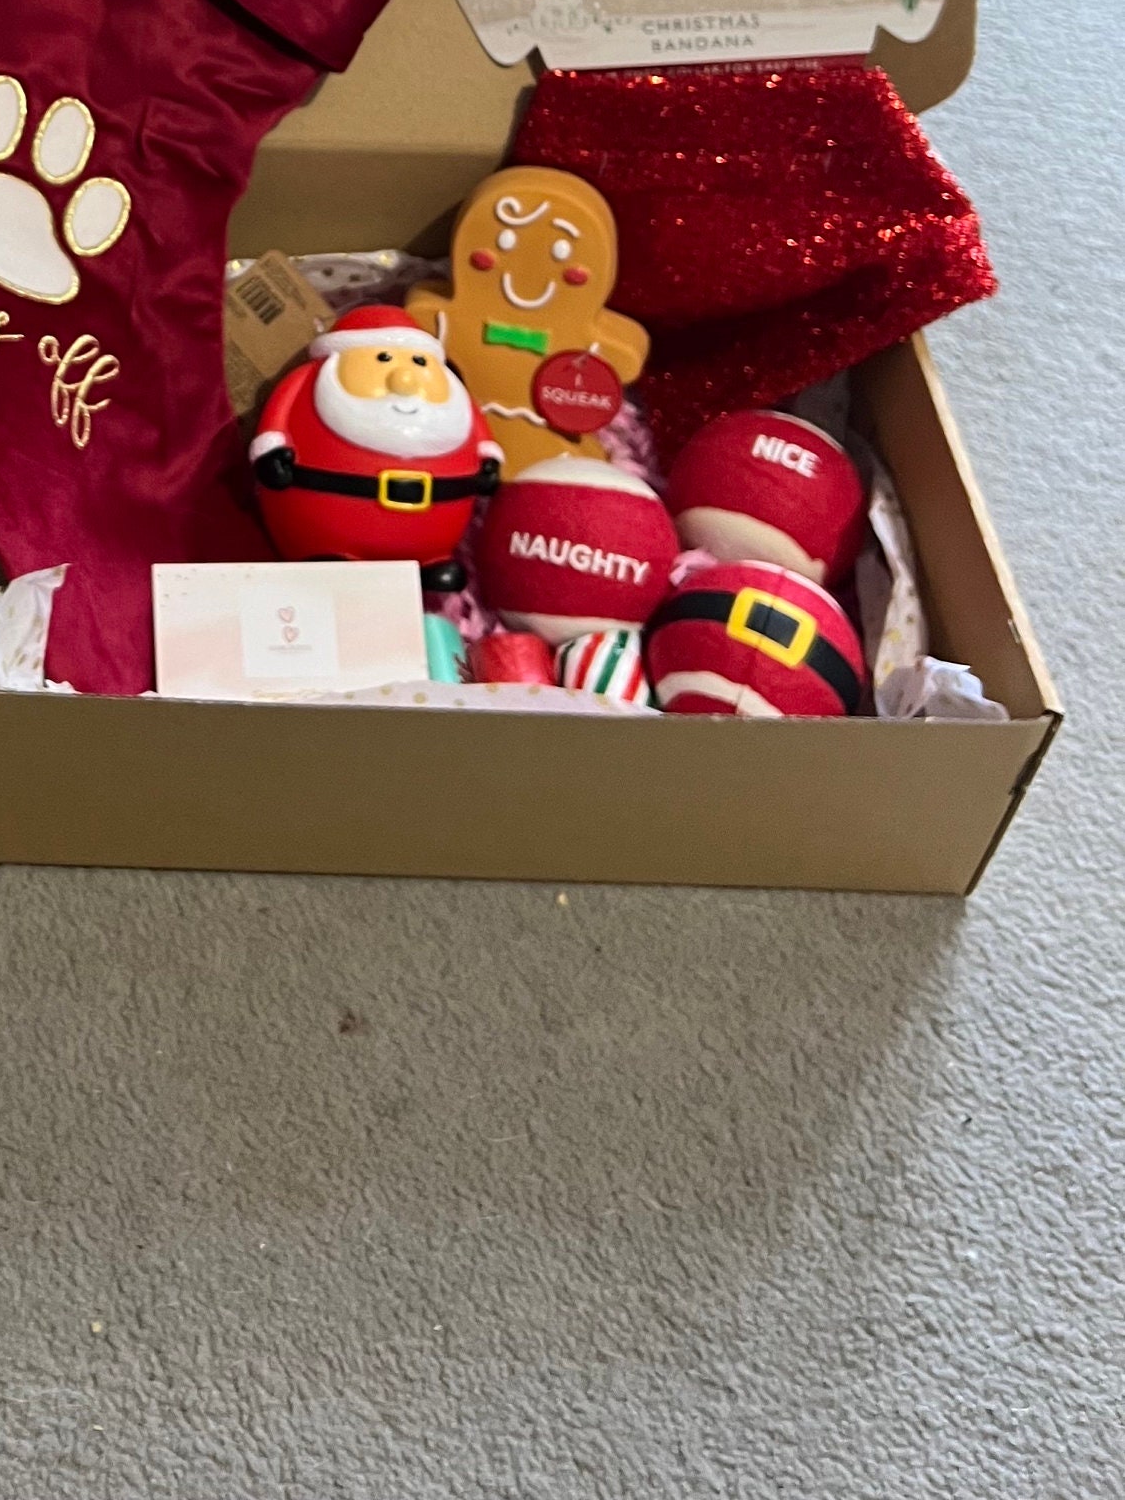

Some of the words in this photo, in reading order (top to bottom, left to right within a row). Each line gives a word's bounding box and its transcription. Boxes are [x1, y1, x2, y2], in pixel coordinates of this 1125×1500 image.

[641, 12, 761, 35] CHRISTMAS
[651, 34, 755, 52] BANDANA
[38, 334, 121, 450] off
[541, 385, 612, 411] SQUEAK
[751, 433, 822, 479] NICE
[509, 530, 651, 586] NAUGHTY
